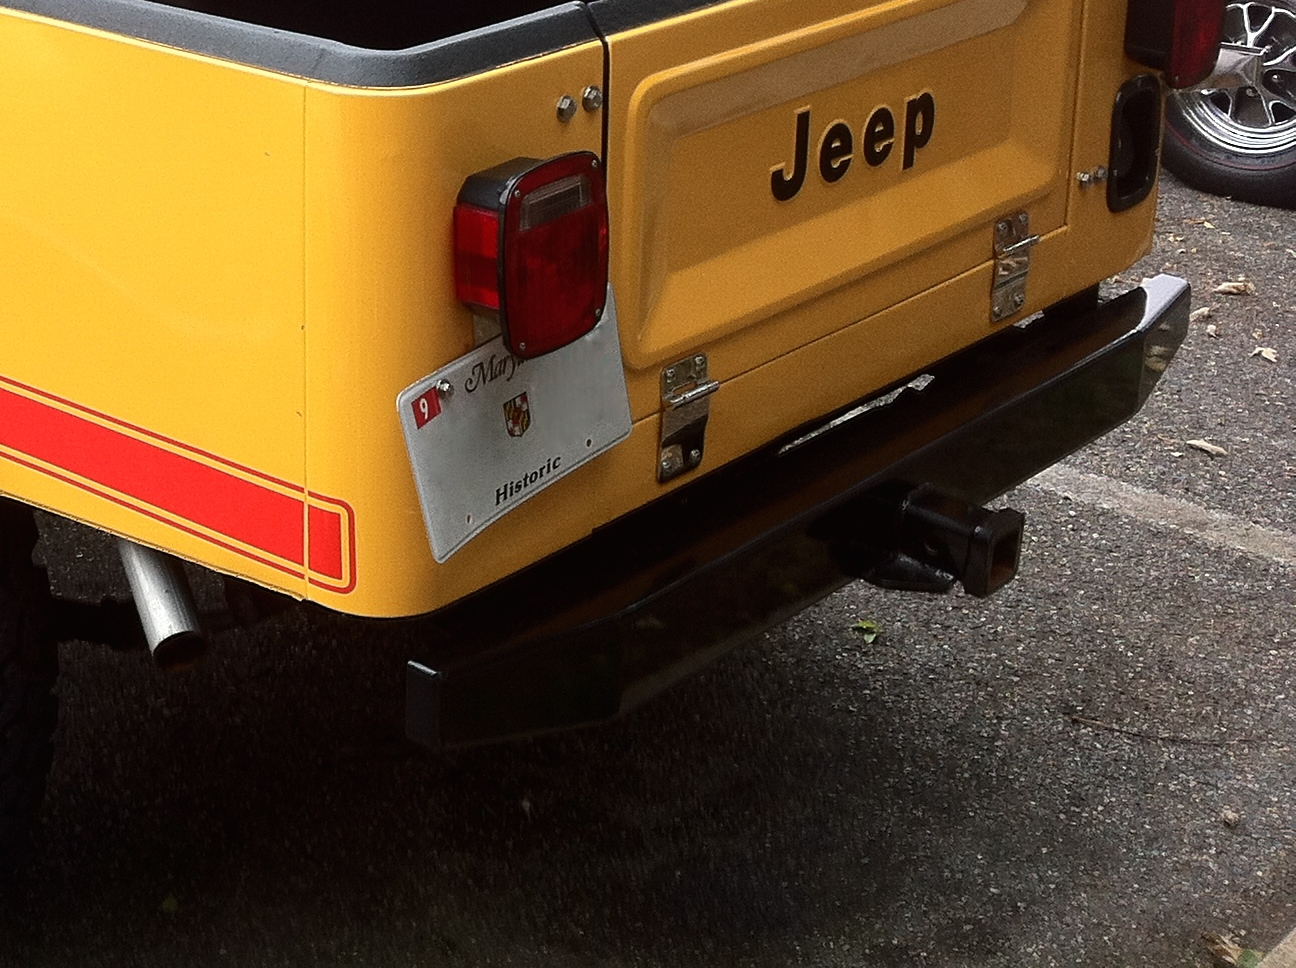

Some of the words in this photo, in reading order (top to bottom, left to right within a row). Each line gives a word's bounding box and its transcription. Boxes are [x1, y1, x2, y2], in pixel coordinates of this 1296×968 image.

[769, 88, 936, 202] Jeep
[419, 397, 430, 420] 9
[495, 456, 562, 507] Historic
